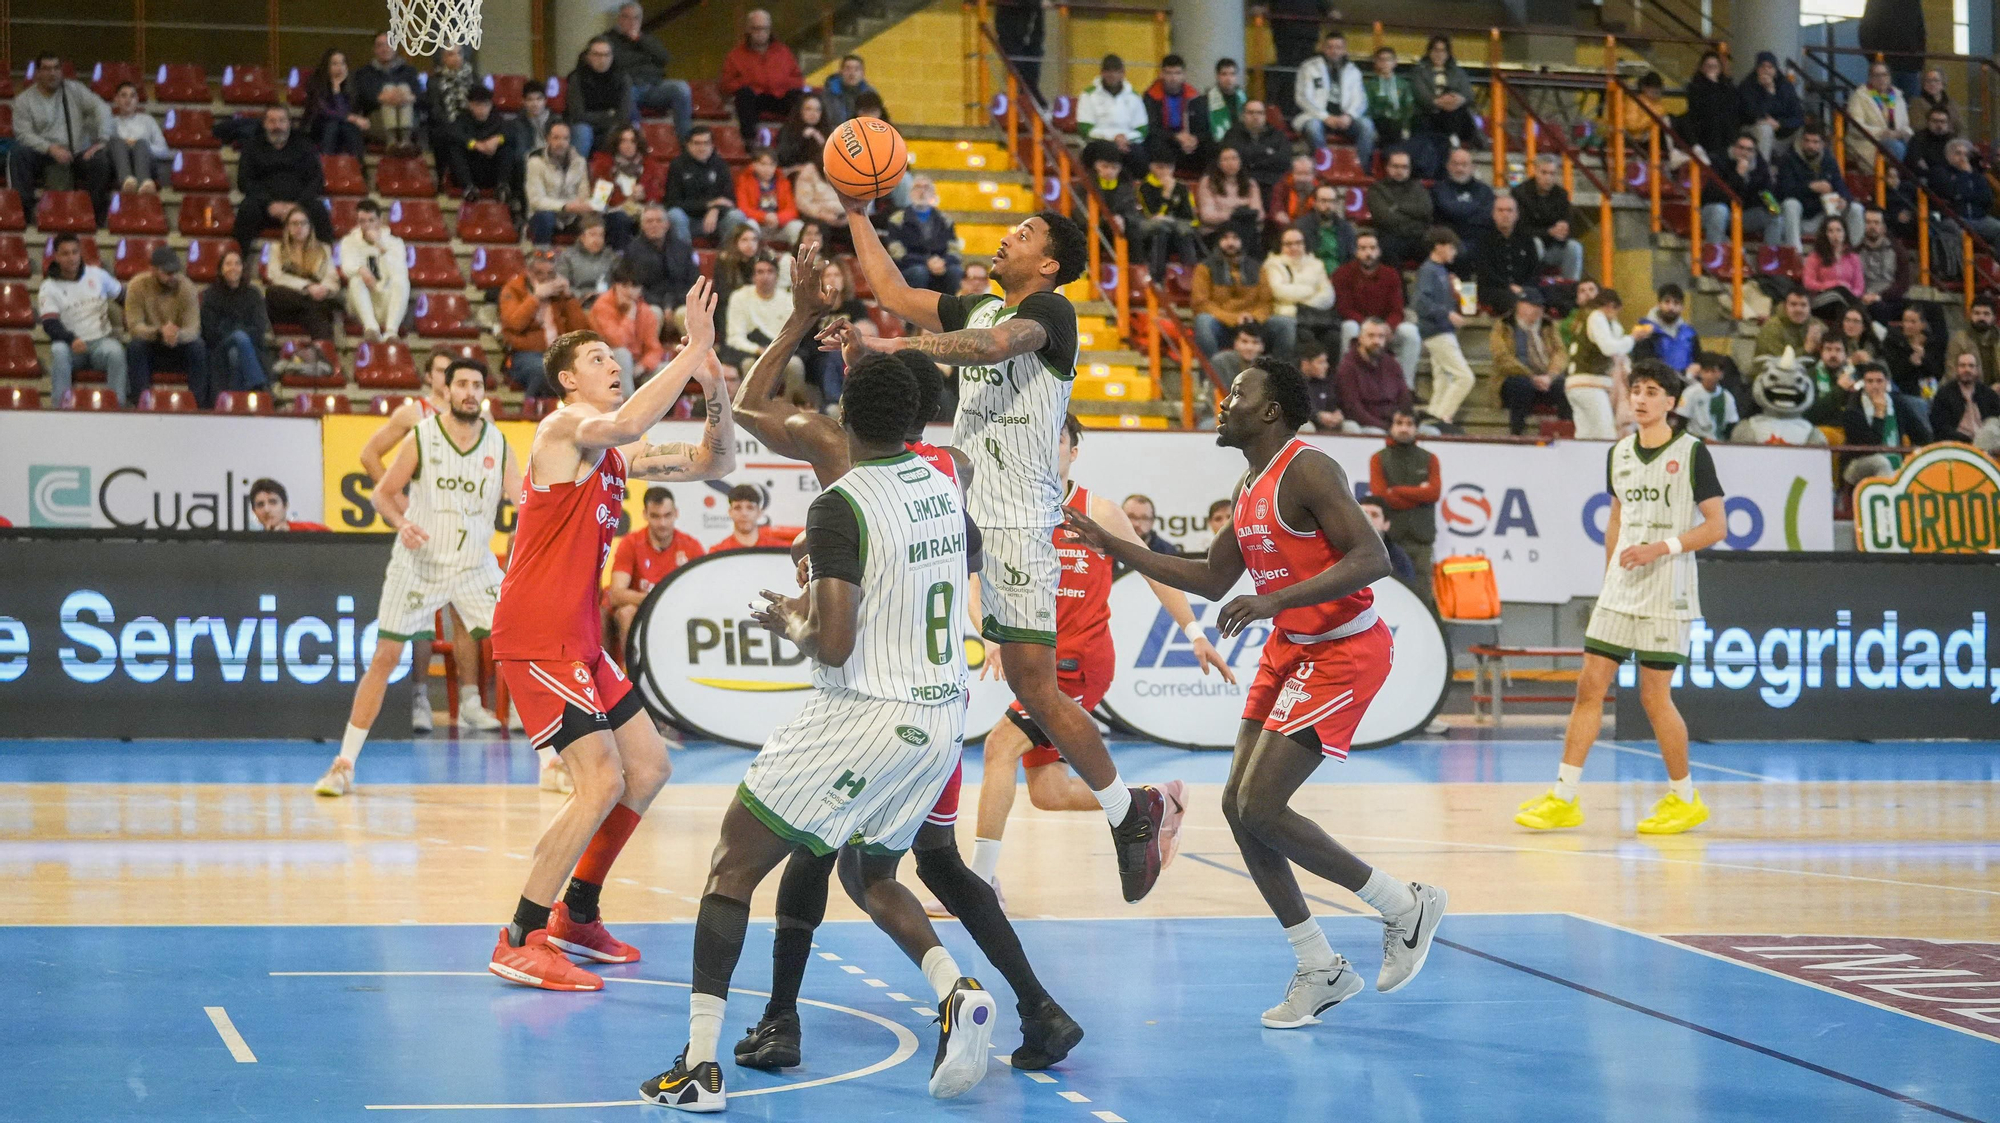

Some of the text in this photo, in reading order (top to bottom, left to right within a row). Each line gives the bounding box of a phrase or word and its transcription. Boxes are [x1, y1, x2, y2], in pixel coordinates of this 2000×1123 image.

[991, 411, 1029, 427] Cajasol
[436, 476, 475, 493] coto
[1626, 485, 1660, 502] coto
[904, 493, 956, 523] LAMINE
[457, 529, 467, 551] 7
[995, 583, 1035, 594] SohoBoutique
[926, 581, 954, 665] 8
[1618, 610, 2000, 708] tegridad,
[911, 682, 960, 701] PiEDRA
[901, 728, 926, 745] Ford
